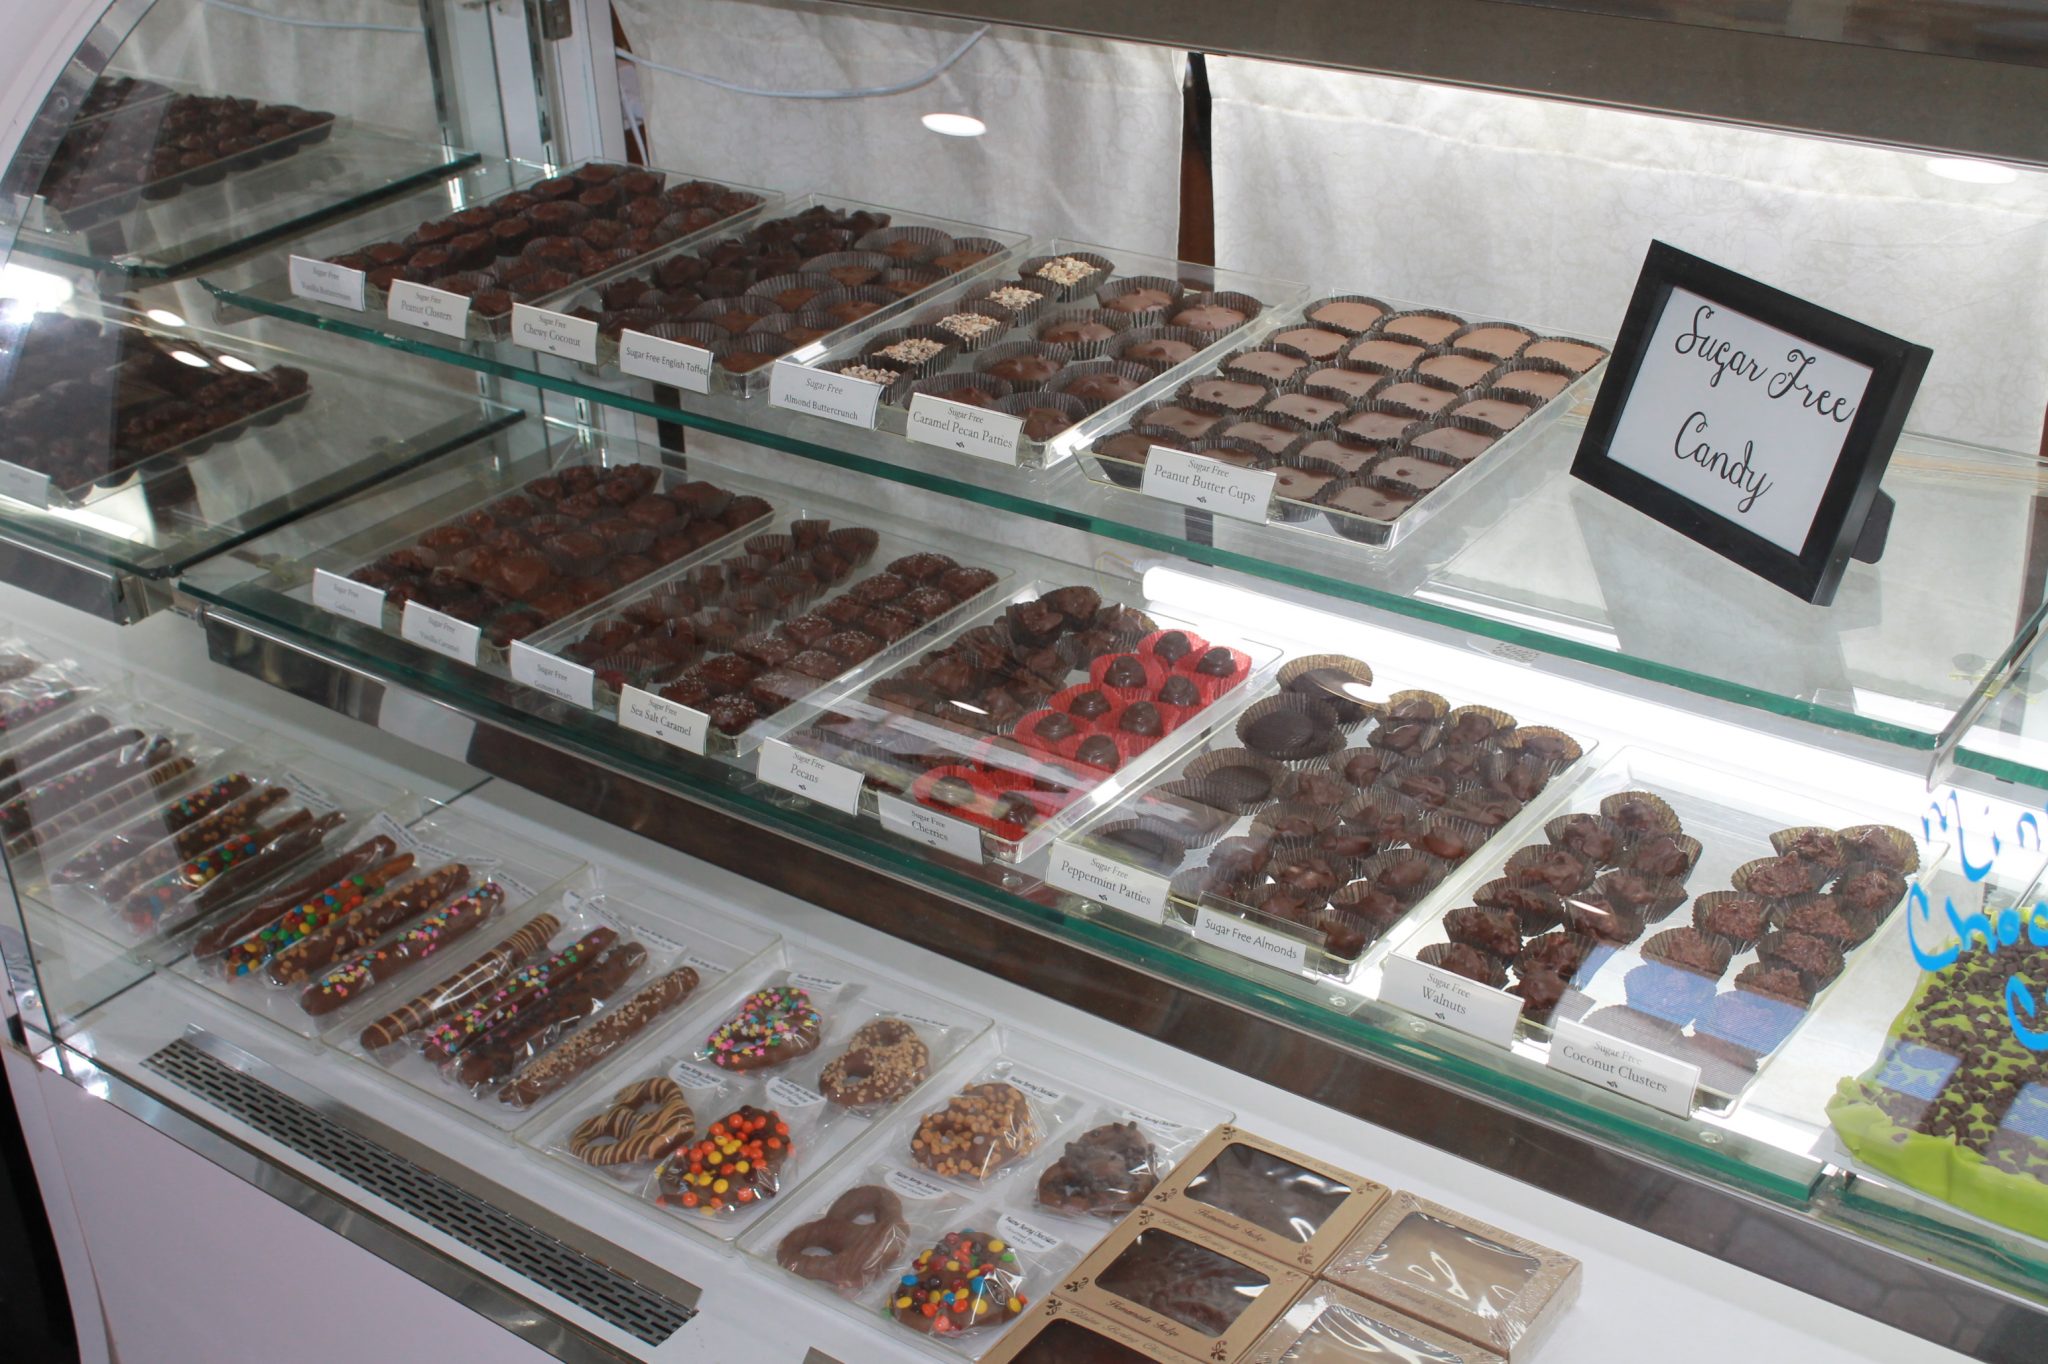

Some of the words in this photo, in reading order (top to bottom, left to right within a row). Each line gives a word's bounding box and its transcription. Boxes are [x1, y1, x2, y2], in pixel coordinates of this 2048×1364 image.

[401, 300, 424, 314] Peanut
[425, 306, 453, 320] Clusters
[416, 292, 430, 302] Sugar
[431, 296, 441, 304] Free
[539, 315, 553, 326] Sugar
[554, 320, 566, 328] Free
[523, 323, 547, 338] Chewy
[549, 330, 581, 347] Coconut
[626, 347, 644, 360] Sugar
[646, 353, 660, 363] Free
[661, 356, 685, 370] English
[686, 362, 708, 376] Toffee
[1675, 305, 1769, 388] Sugar
[1767, 349, 1855, 423] Free
[806, 378, 824, 391] Sugar
[825, 384, 843, 395] Free
[784, 394, 811, 409] Almond
[812, 400, 858, 420] Buttercrunch
[947, 406, 967, 420] Sugar
[967, 413, 984, 424] Free
[913, 411, 950, 430] Caramel
[951, 421, 979, 439] Pecan
[981, 429, 1013, 448] Patties
[1188, 459, 1211, 475] Sugar
[1212, 467, 1229, 478] Free
[1674, 411, 1773, 513] Candy
[1154, 464, 1190, 485] Peanut
[1192, 474, 1226, 494] Butter
[1228, 485, 1256, 504] Cups
[537, 664, 554, 677] Sugar
[555, 671, 567, 681] Free
[630, 704, 643, 717] Sea
[644, 709, 659, 723] Salt
[660, 716, 692, 737] Caramel
[648, 700, 664, 713] Sugar
[665, 706, 677, 717] Free
[790, 763, 819, 784] Pecans
[792, 752, 809, 765] Sugar
[810, 758, 825, 770] Free
[911, 810, 931, 825] Sugar
[932, 817, 946, 828] Free
[911, 819, 948, 841] Cherries
[1921, 789, 2048, 882] Min
[1090, 857, 1110, 874] Sugar
[1111, 867, 1129, 880] Free
[1061, 860, 1117, 893] Peppermint
[1118, 884, 1152, 906] Patties
[1204, 917, 1230, 938] Sugar
[1232, 926, 1252, 942] Free
[1254, 934, 1298, 959] Almonds
[1427, 971, 1449, 993] Sugar
[1451, 982, 1472, 999] Free
[1422, 986, 1468, 1016] Walnuts
[1594, 1040, 1619, 1062] Sugar
[1621, 1050, 1643, 1066] Free
[1562, 1045, 1615, 1077] Coconut
[1617, 1065, 1669, 1095] Clusters
[1194, 1208, 1239, 1231] Homemade
[1242, 1225, 1267, 1242] Fudge
[1105, 1299, 1152, 1324] Homemade
[1153, 1321, 1179, 1337] Fudge
